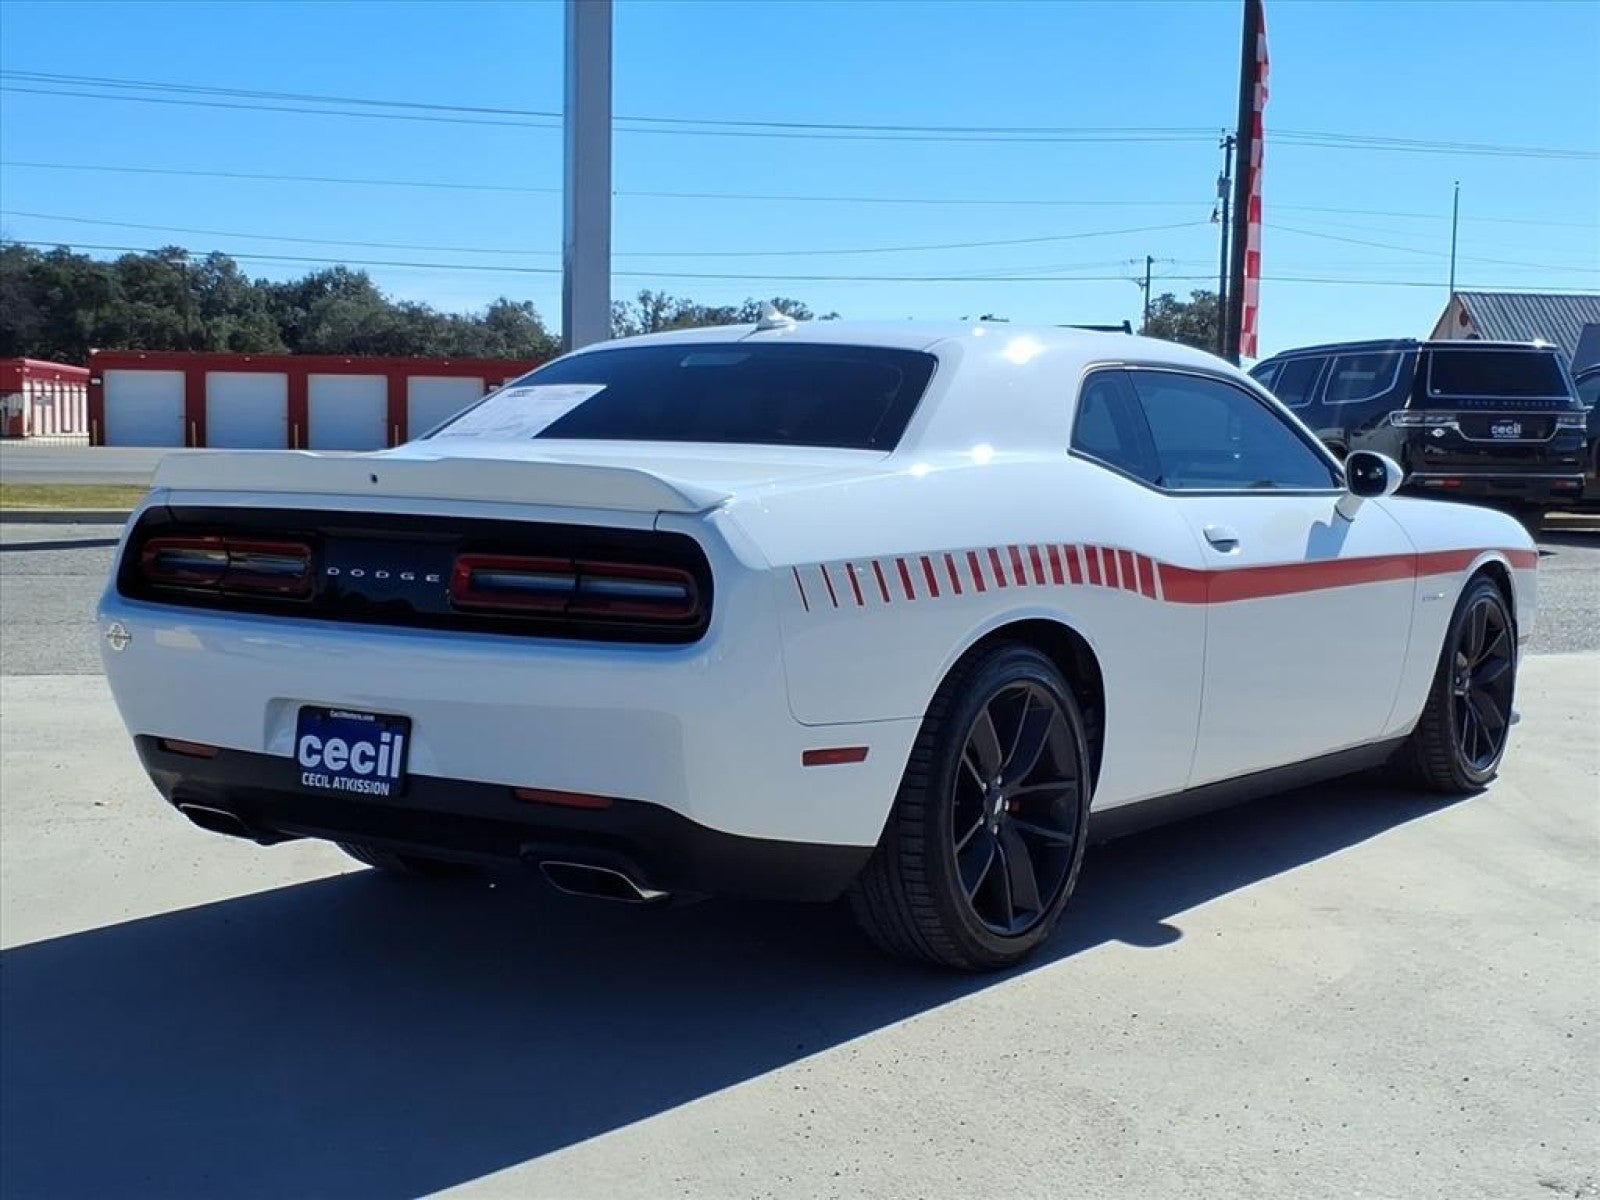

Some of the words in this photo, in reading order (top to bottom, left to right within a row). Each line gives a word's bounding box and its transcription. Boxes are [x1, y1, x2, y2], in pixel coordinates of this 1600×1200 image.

[327, 567, 440, 582] DODGE
[299, 732, 403, 778] cecil
[302, 772, 331, 788] CECIL
[332, 776, 390, 796] ATKISSION
